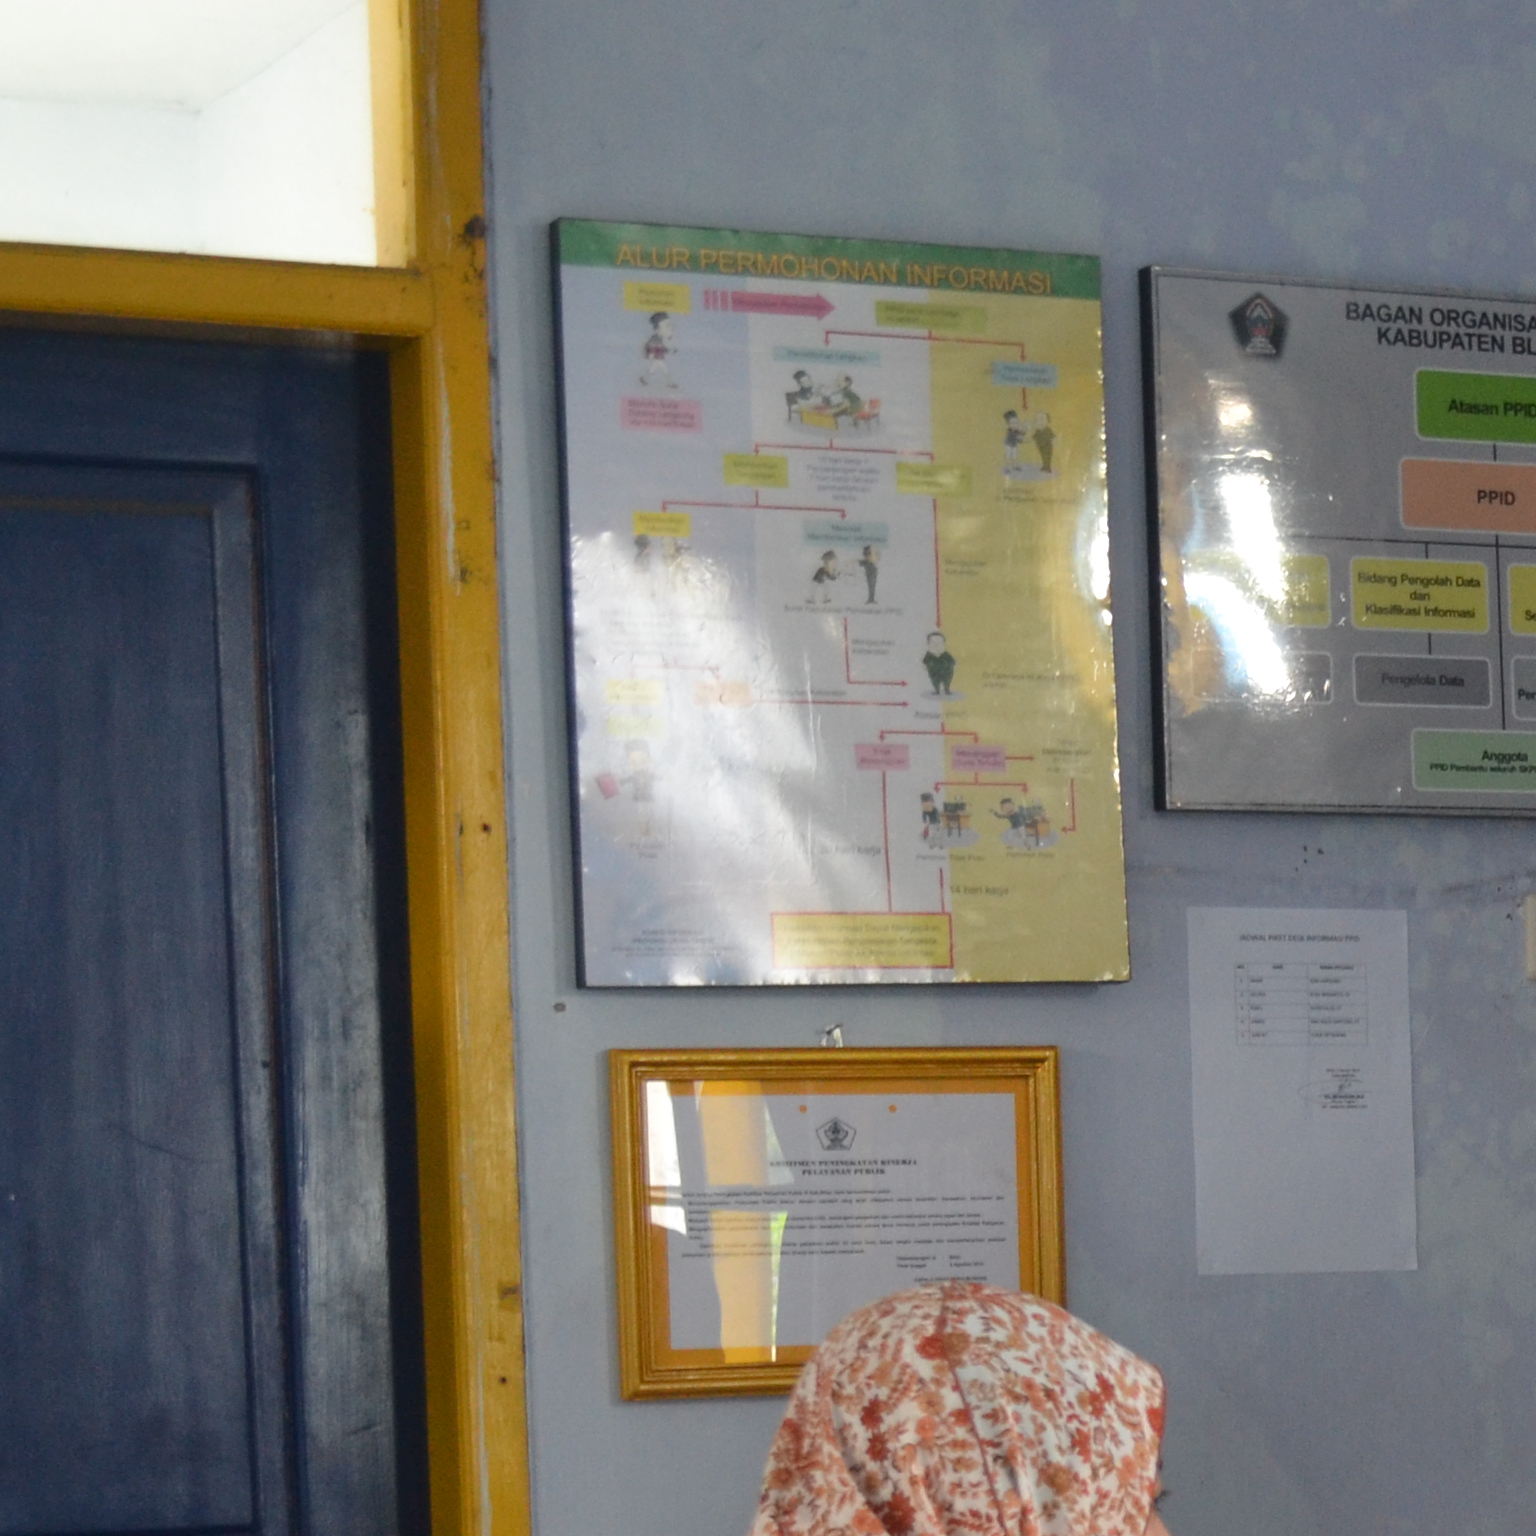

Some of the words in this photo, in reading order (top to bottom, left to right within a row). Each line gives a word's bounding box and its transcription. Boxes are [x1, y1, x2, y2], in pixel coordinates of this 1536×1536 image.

[616, 243, 691, 270] ALUR
[700, 249, 897, 284] PERMOHONAN
[906, 261, 1051, 294] INFORMASI
[1345, 301, 1422, 324] BAGAN
[1377, 326, 1505, 353] KABUPATEN
[1447, 398, 1499, 416] Atasan
[1476, 489, 1516, 507] PPID
[1357, 571, 1397, 588] Bidang
[1400, 573, 1450, 590] Pengolah
[1455, 575, 1481, 588] Data
[1409, 590, 1431, 601] dan
[1364, 602, 1421, 617] Klasifikasi
[1424, 605, 1476, 619] Informasi
[1381, 672, 1436, 688] Pengelola
[1439, 675, 1465, 687] Data
[1481, 750, 1528, 764] Anggota
